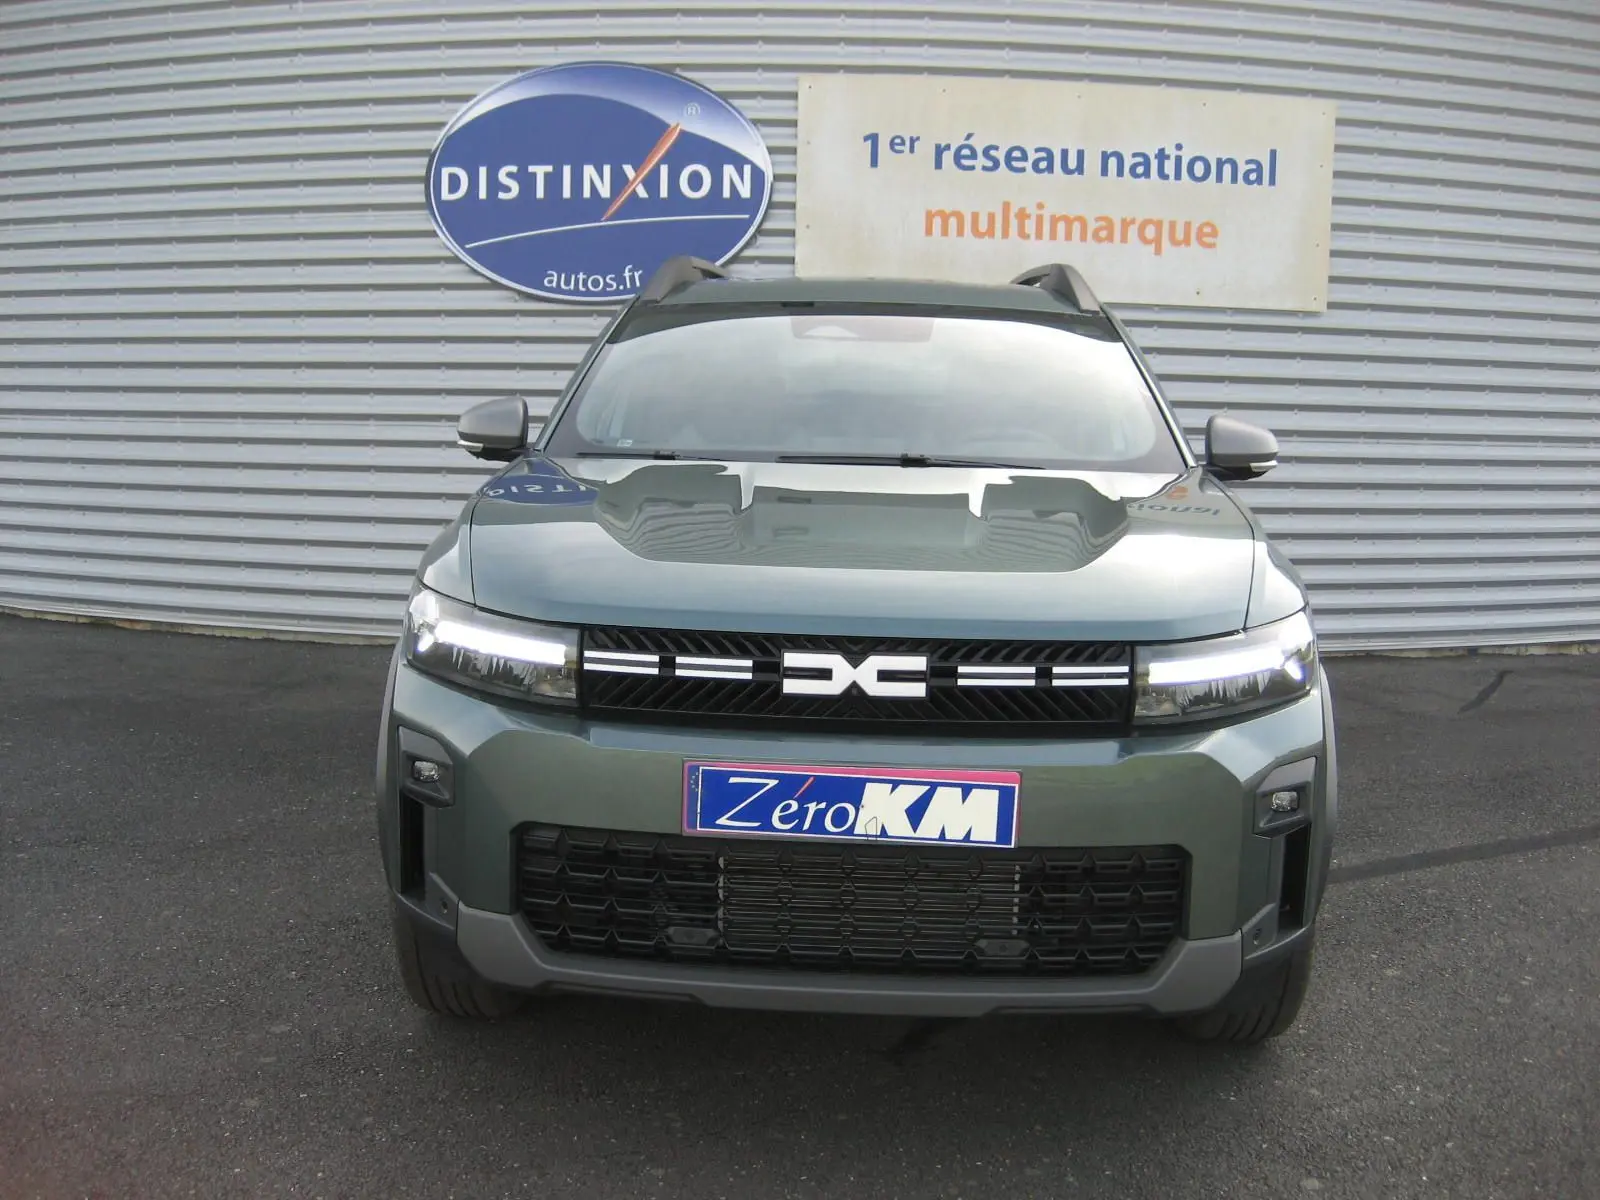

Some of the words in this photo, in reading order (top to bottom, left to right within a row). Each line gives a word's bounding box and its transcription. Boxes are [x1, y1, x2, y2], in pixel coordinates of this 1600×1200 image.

[440, 163, 752, 201] DISTINXION
[862, 132, 921, 169] 1er
[933, 132, 1085, 176] réseau
[1099, 143, 1278, 187] national
[923, 201, 1220, 256] multimarque
[543, 264, 643, 292] autos.fr
